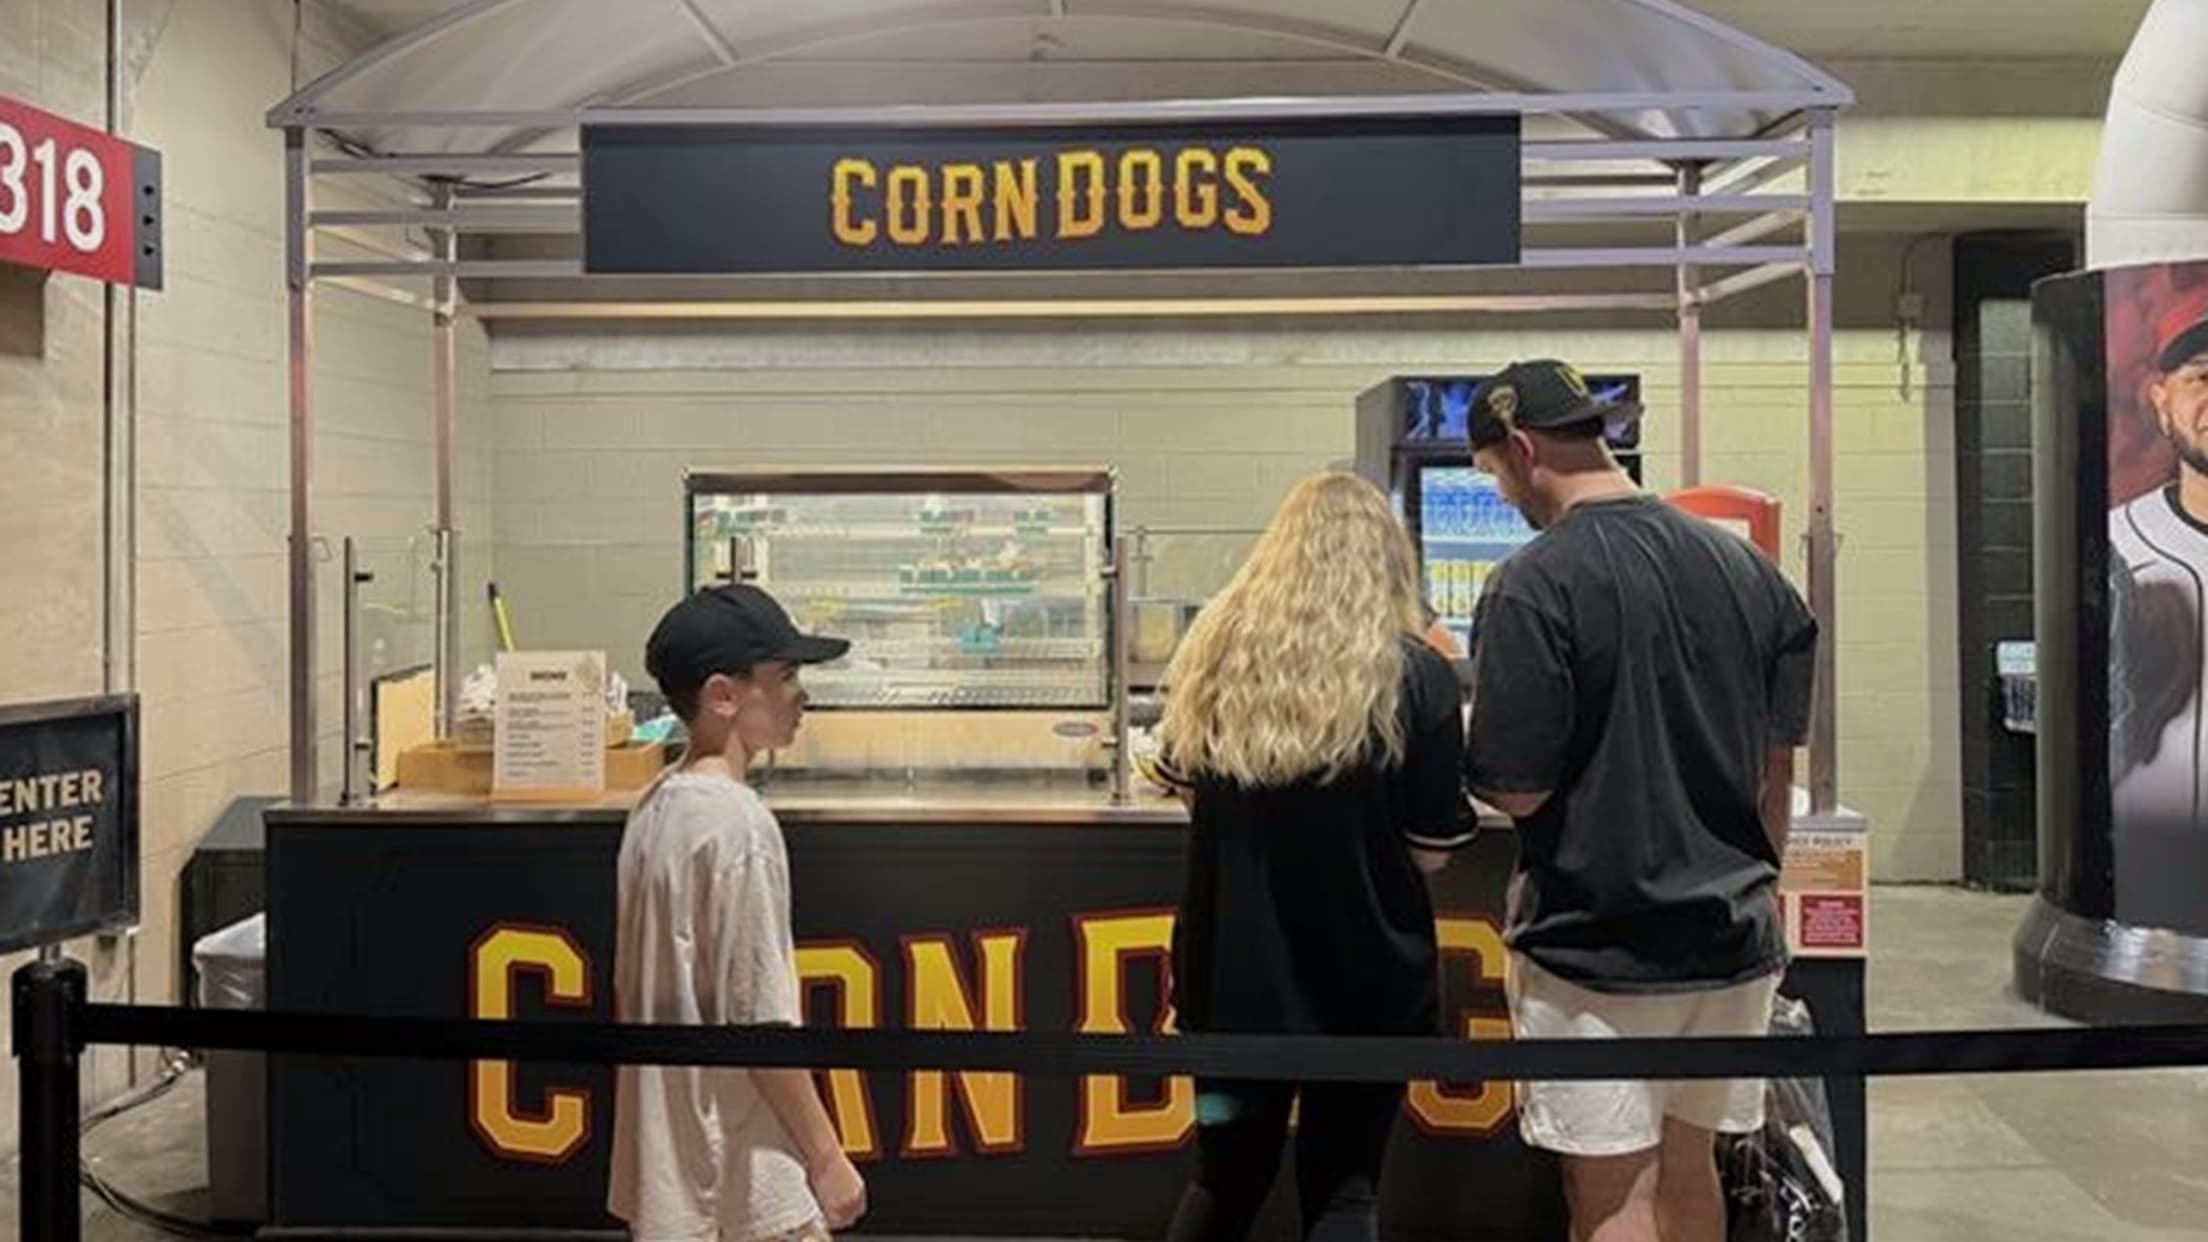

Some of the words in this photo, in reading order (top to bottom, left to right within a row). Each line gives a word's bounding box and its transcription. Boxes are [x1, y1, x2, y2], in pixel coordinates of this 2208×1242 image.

[0, 121, 105, 252] 318
[831, 157, 1039, 246] CORN
[1056, 146, 1272, 236] DOGS
[0, 769, 103, 816] ENTER
[3, 815, 93, 861] HERE
[469, 922, 1026, 1163] CRN
